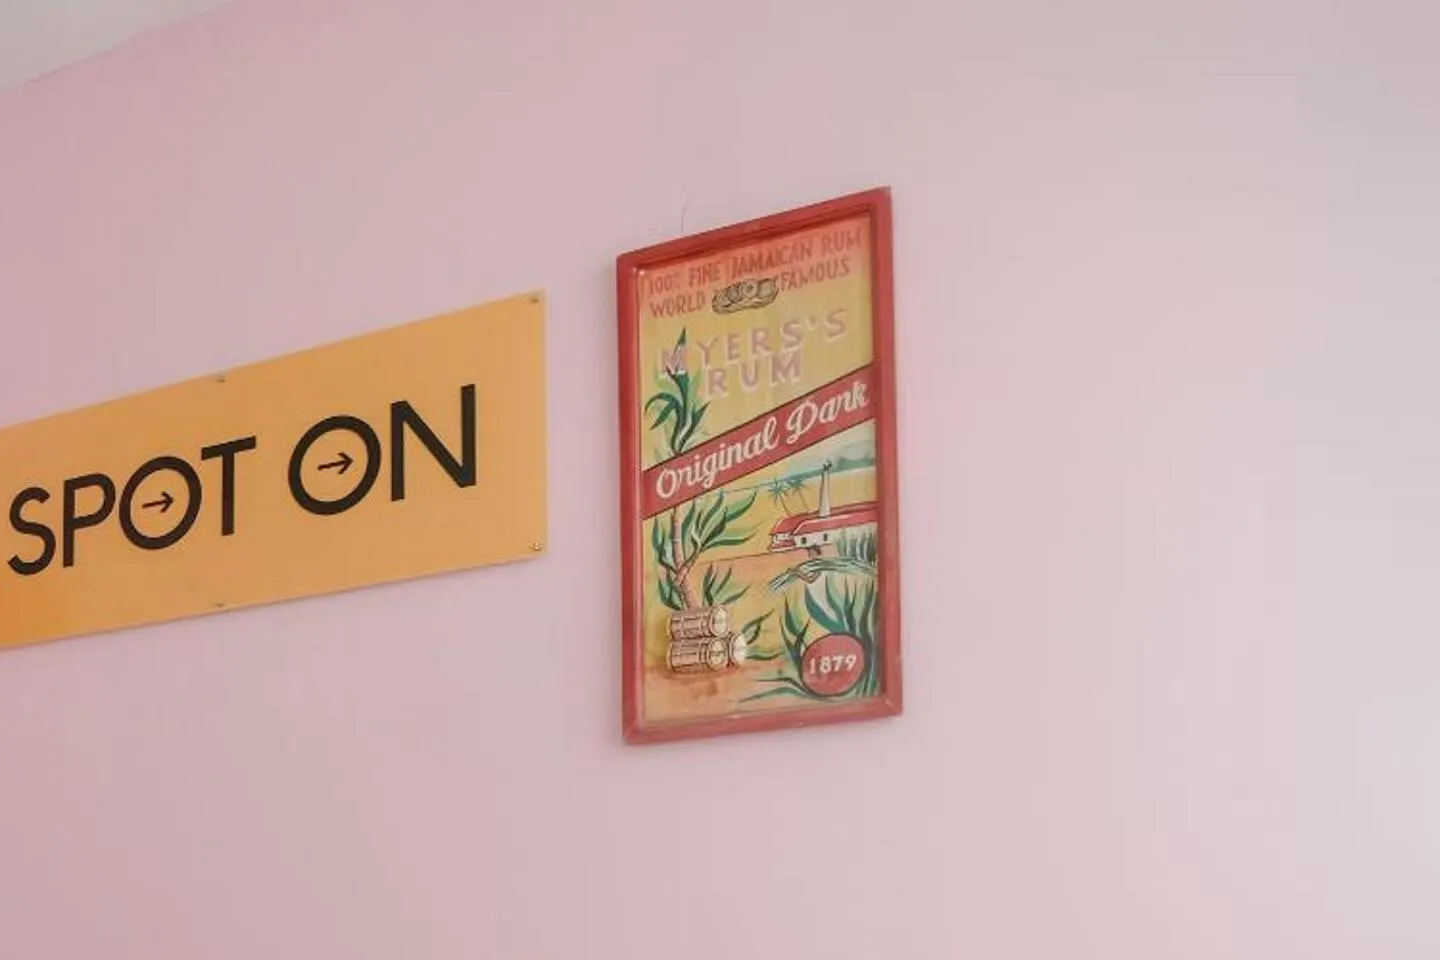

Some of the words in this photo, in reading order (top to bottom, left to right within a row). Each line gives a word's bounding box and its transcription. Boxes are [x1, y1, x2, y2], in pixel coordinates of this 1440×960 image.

[688, 261, 721, 288] FINE
[731, 239, 812, 279] JAMAICAN
[821, 227, 863, 256] RUM
[649, 291, 706, 318] WORLD
[781, 258, 850, 292] FAMOUS
[707, 351, 802, 397] RUM
[656, 417, 780, 498] Original
[786, 381, 868, 445] Dark
[8, 435, 257, 576] SPOT
[287, 383, 477, 516] ON
[809, 654, 857, 675] 1879
